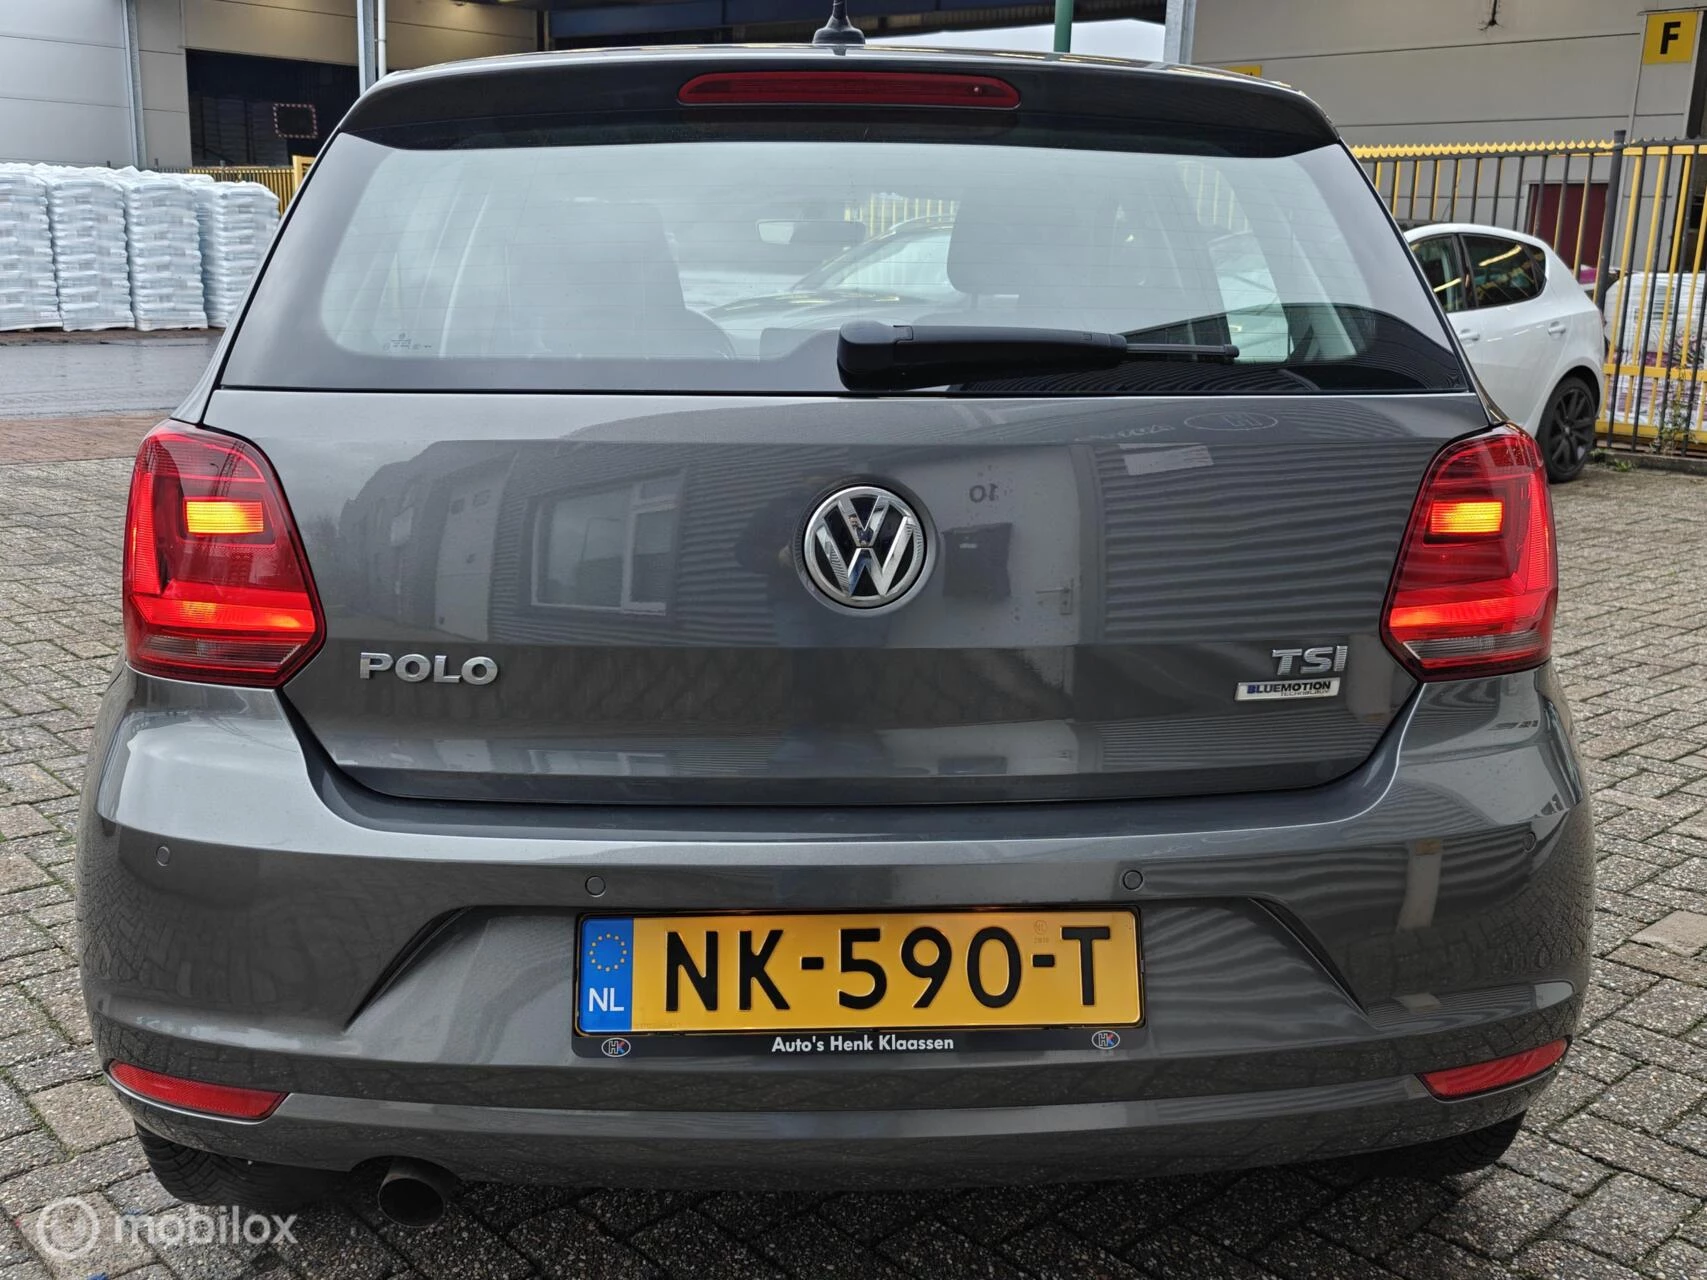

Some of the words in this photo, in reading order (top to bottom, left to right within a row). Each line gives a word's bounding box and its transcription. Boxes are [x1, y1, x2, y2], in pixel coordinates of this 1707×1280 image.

[1660, 21, 1681, 55] F
[805, 486, 926, 609] VW
[359, 652, 498, 685] POLO
[1271, 645, 1348, 676] TSI
[1246, 681, 1331, 694] BLUEMOTION
[664, 925, 1111, 1012] NK-590-T
[588, 987, 625, 1012] NL
[771, 1036, 825, 1053] Auto's
[830, 1034, 873, 1051] Henk
[879, 1034, 955, 1051] Klaassen
